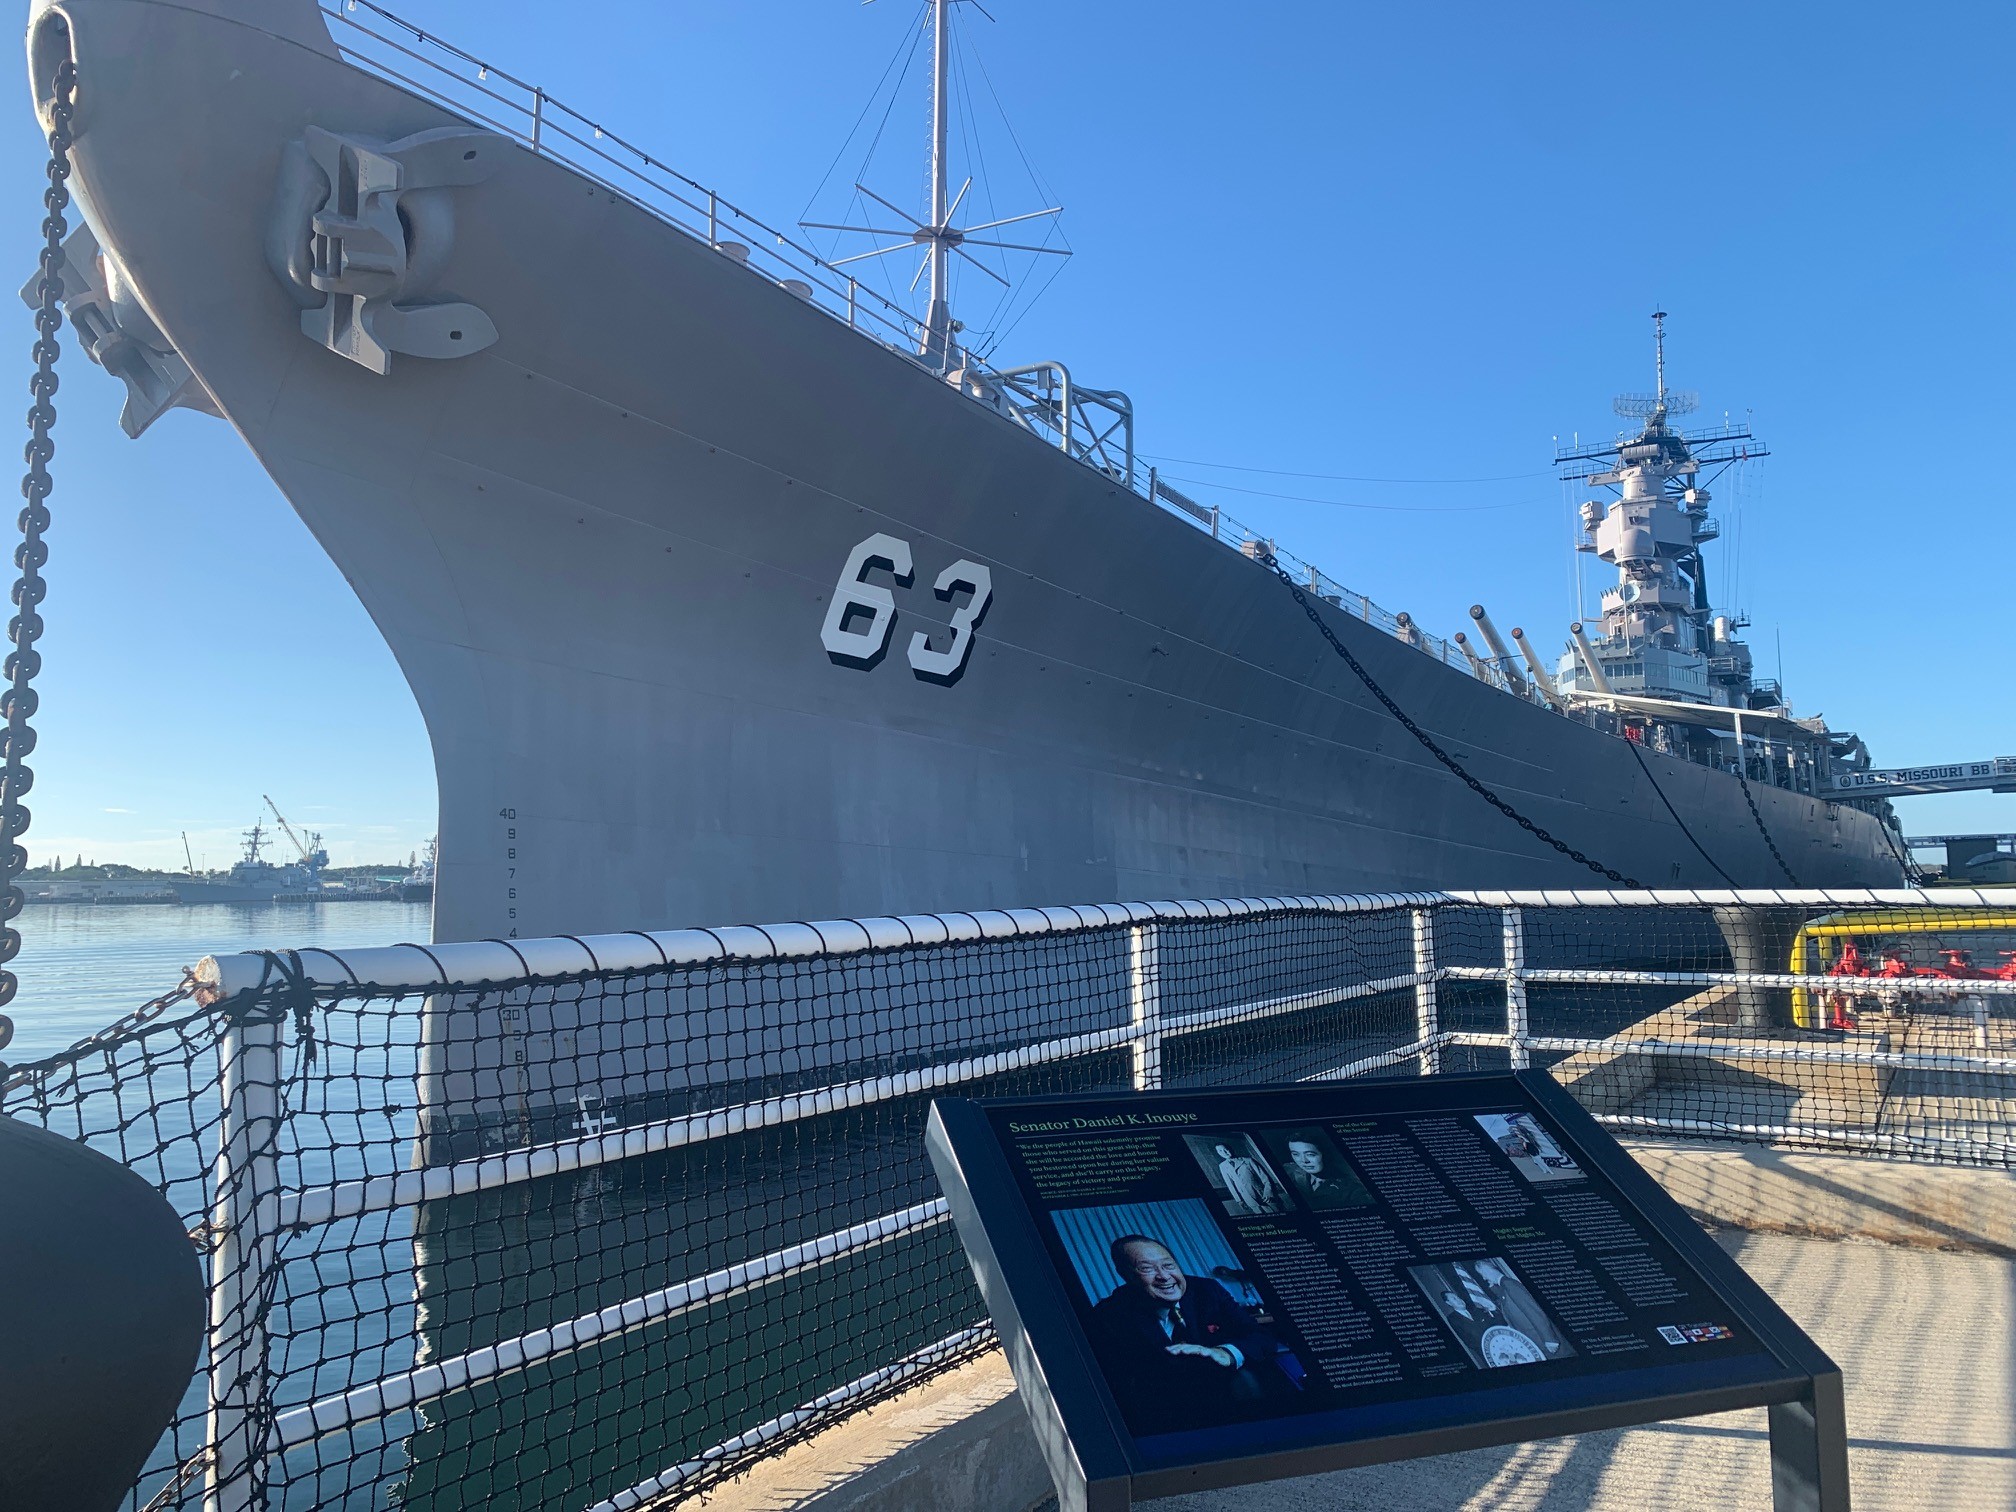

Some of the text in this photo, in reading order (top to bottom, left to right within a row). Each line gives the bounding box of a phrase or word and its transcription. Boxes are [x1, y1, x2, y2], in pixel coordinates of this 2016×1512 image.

[820, 533, 993, 681] 63
[1855, 774, 1891, 785] U.S.S.
[1898, 767, 1963, 782] MISSOURI
[499, 808, 516, 819] 40
[508, 828, 515, 839] 9
[508, 848, 515, 859] 8
[509, 868, 515, 878] 7
[509, 888, 516, 898] 6
[509, 908, 516, 918] 5
[509, 928, 517, 938] 4
[503, 1009, 519, 1021] 30
[515, 1051, 523, 1061] 8
[1010, 1112, 1198, 1133] Senator Daniel K. Inouye
